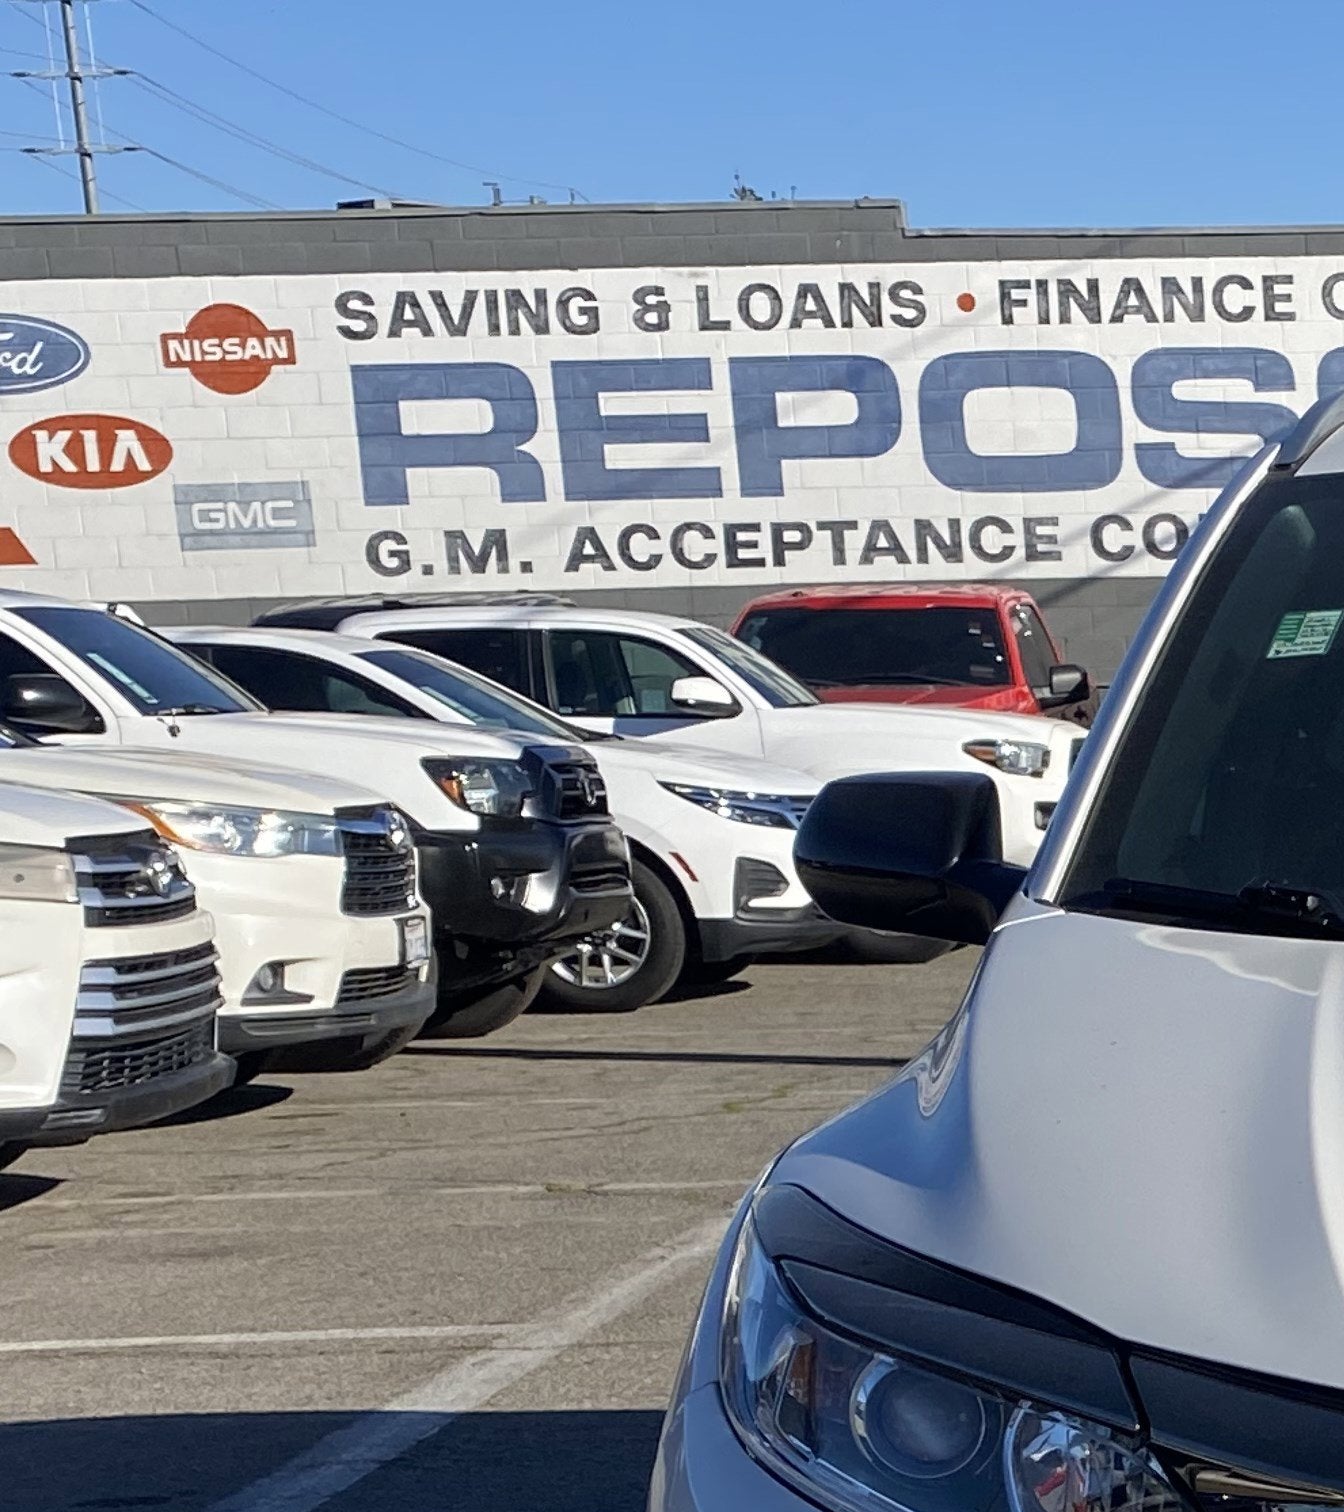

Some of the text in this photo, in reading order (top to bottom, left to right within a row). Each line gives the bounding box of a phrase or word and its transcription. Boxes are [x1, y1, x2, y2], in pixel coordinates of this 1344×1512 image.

[335, 287, 600, 341] SAVING
[631, 285, 672, 333] &
[695, 280, 928, 332] LOANS
[998, 273, 1297, 327] FINANCE
[167, 336, 289, 364] NISSAN
[31, 429, 153, 473] KIA
[190, 499, 297, 531] GMC
[364, 529, 533, 578] G.M.
[563, 515, 1062, 574] ACCEPTANCE
[1089, 512, 1208, 562] CO
